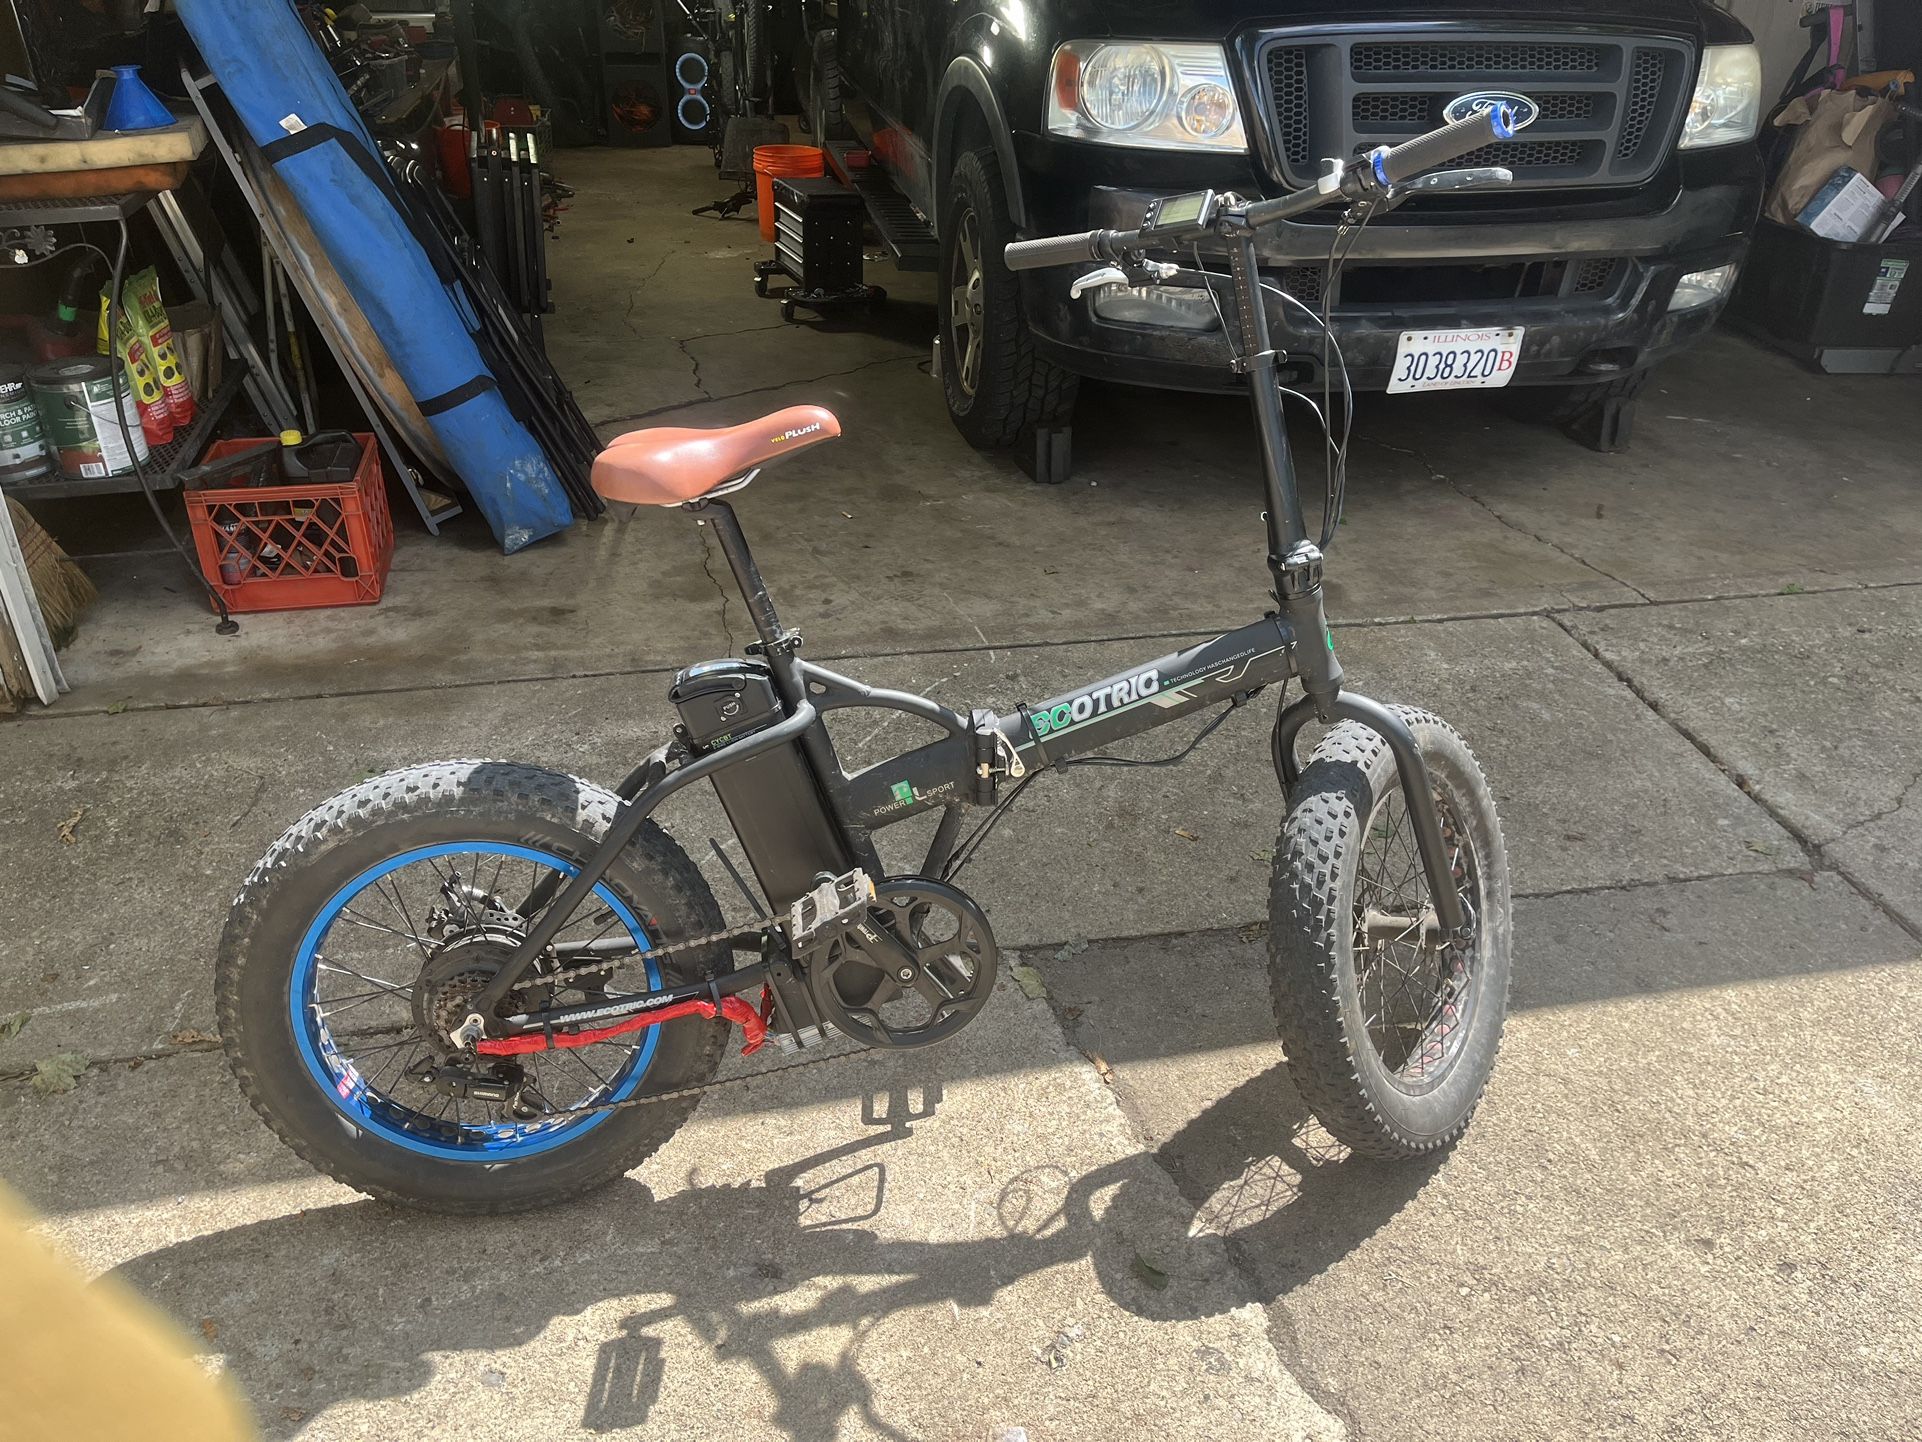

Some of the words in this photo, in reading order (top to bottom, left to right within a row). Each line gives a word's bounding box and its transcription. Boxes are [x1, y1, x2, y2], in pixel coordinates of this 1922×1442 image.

[1433, 332, 1492, 344] ILLINOIS
[0, 382, 17, 394] EHR
[0, 410, 16, 420] RCH
[0, 416, 21, 427] LOOR
[785, 422, 820, 439] PLUSH
[1170, 667, 1207, 684] TECHNOLOGY
[1029, 668, 1160, 737] ECOTRIC
[873, 800, 907, 817] POWER
[926, 781, 955, 797] SPORT
[559, 994, 674, 1023] WWW.ECOTRIC.COM
